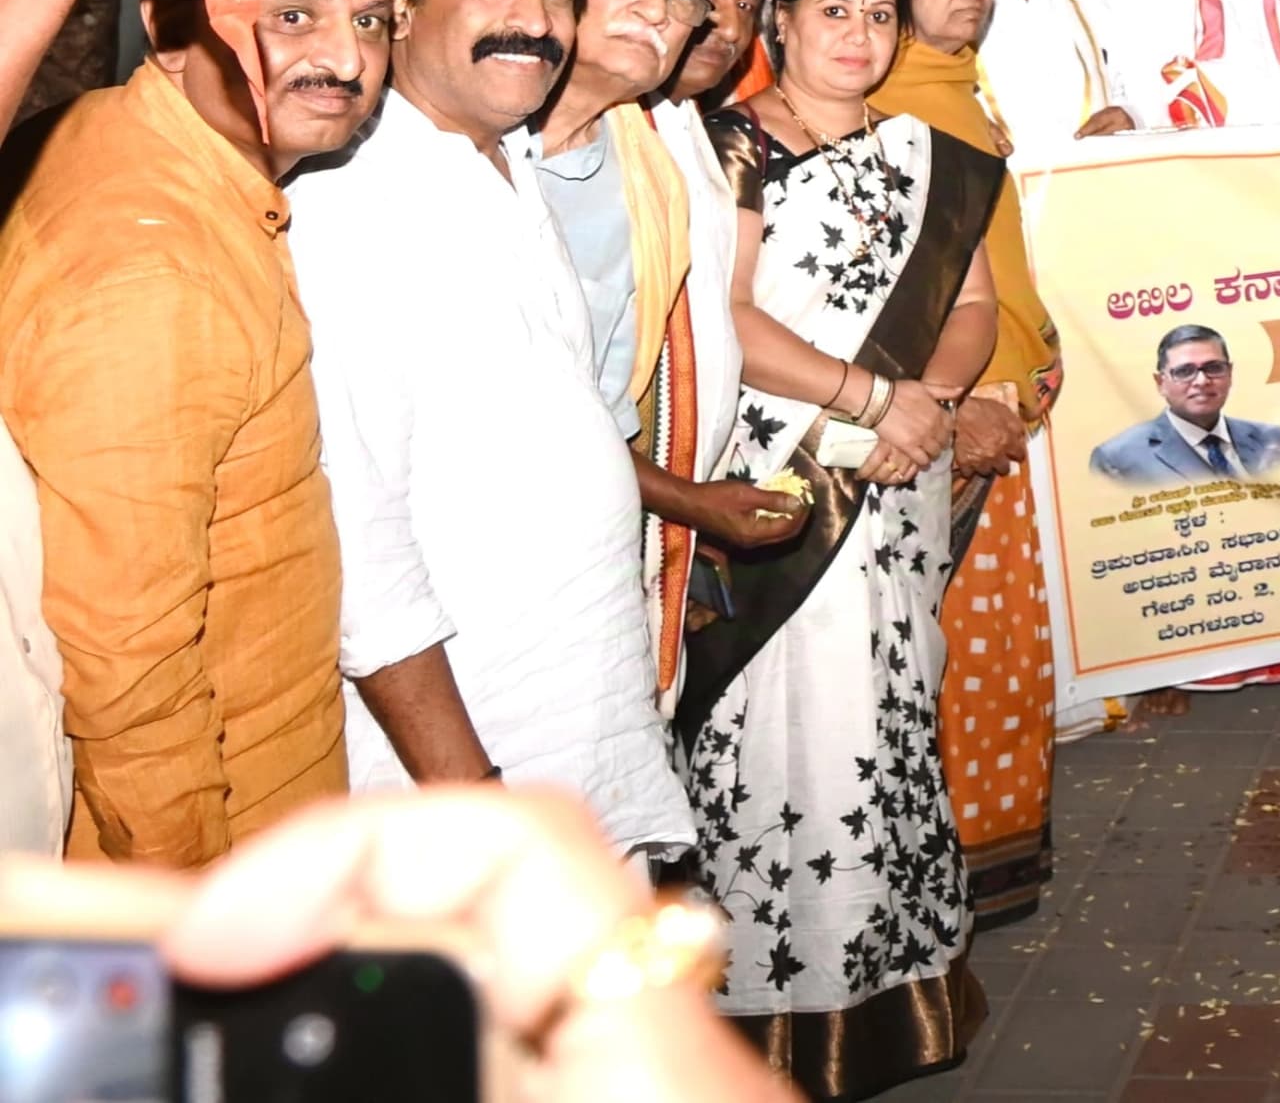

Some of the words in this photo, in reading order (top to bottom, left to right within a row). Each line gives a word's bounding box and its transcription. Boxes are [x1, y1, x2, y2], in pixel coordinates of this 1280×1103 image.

[1107, 280, 1193, 319] ಅಖಿಲ
[1174, 512, 1207, 537] ಸ್ಥಳ
[1091, 539, 1210, 579] ತ್ರಿಪುರವಾಸಿನಿ
[1123, 567, 1197, 594] ಅರಮನೆ
[1142, 594, 1195, 618] ಗೇಟ್
[1158, 610, 1265, 641] ಬೆಂಗಳೂರು
